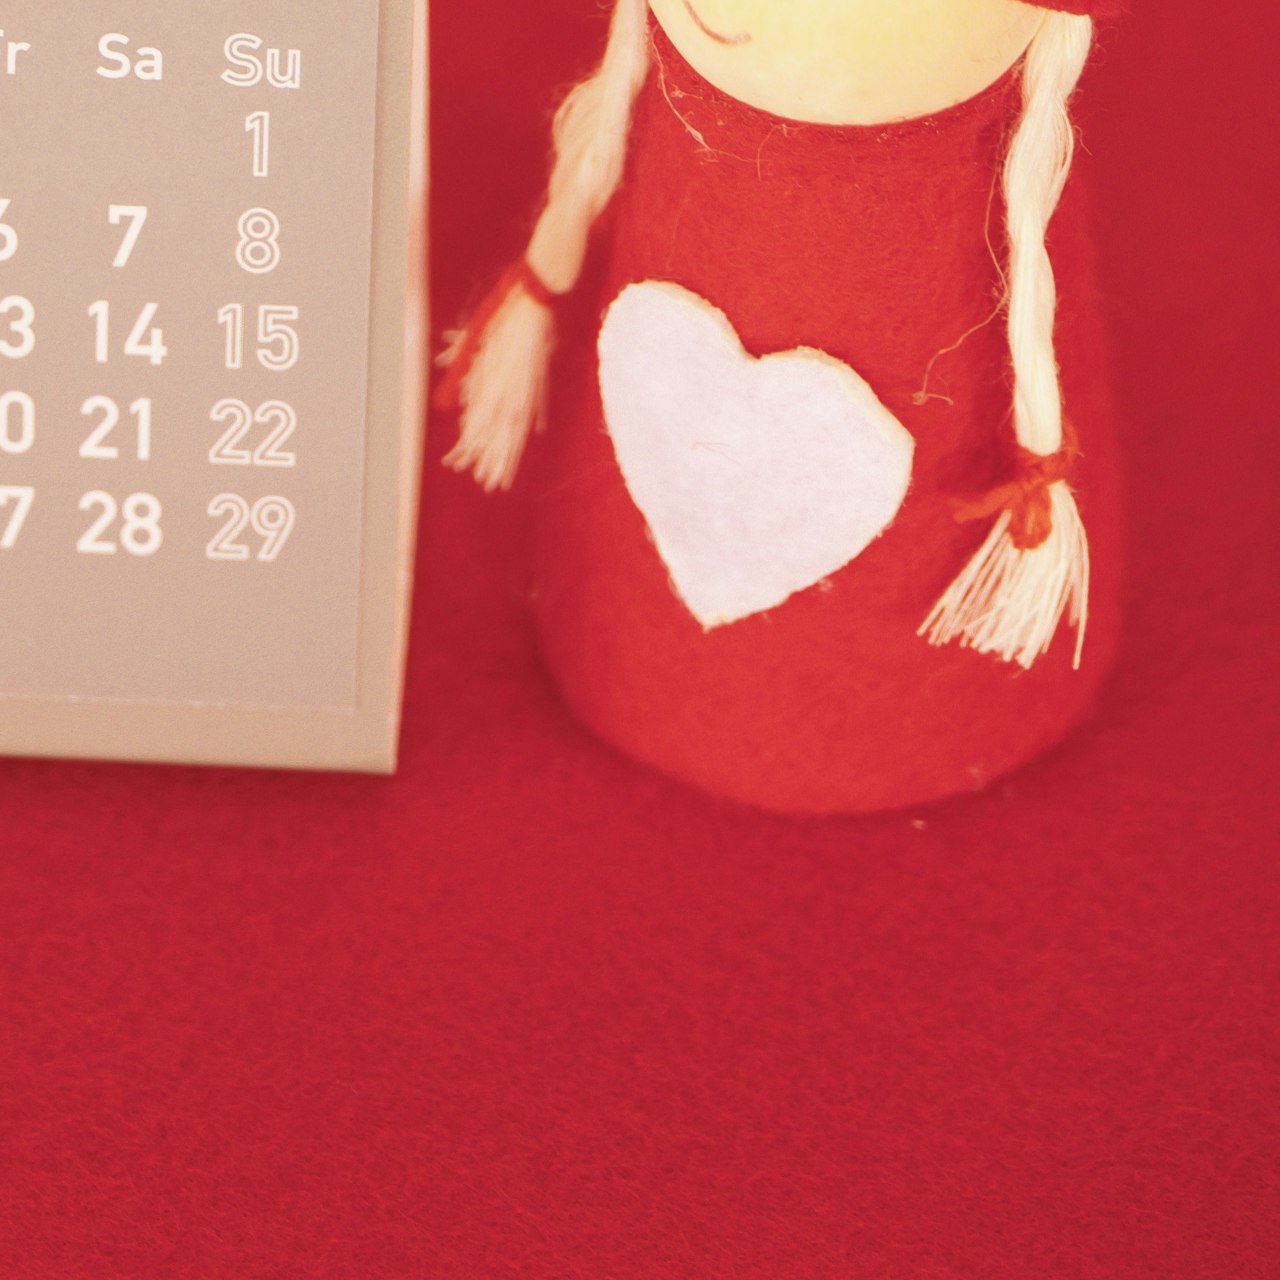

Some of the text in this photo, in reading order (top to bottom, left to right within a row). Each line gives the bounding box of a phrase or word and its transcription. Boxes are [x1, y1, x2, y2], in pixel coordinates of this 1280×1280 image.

[96, 32, 163, 81] Sa
[220, 32, 302, 90] Su
[244, 110, 270, 178] 1
[108, 204, 148, 268] 7
[234, 207, 281, 275] 8
[88, 300, 167, 365] 14
[217, 302, 300, 372] 15
[79, 395, 151, 460] 21
[208, 397, 297, 468] 22
[77, 490, 162, 556] 28
[205, 492, 296, 562] 29
